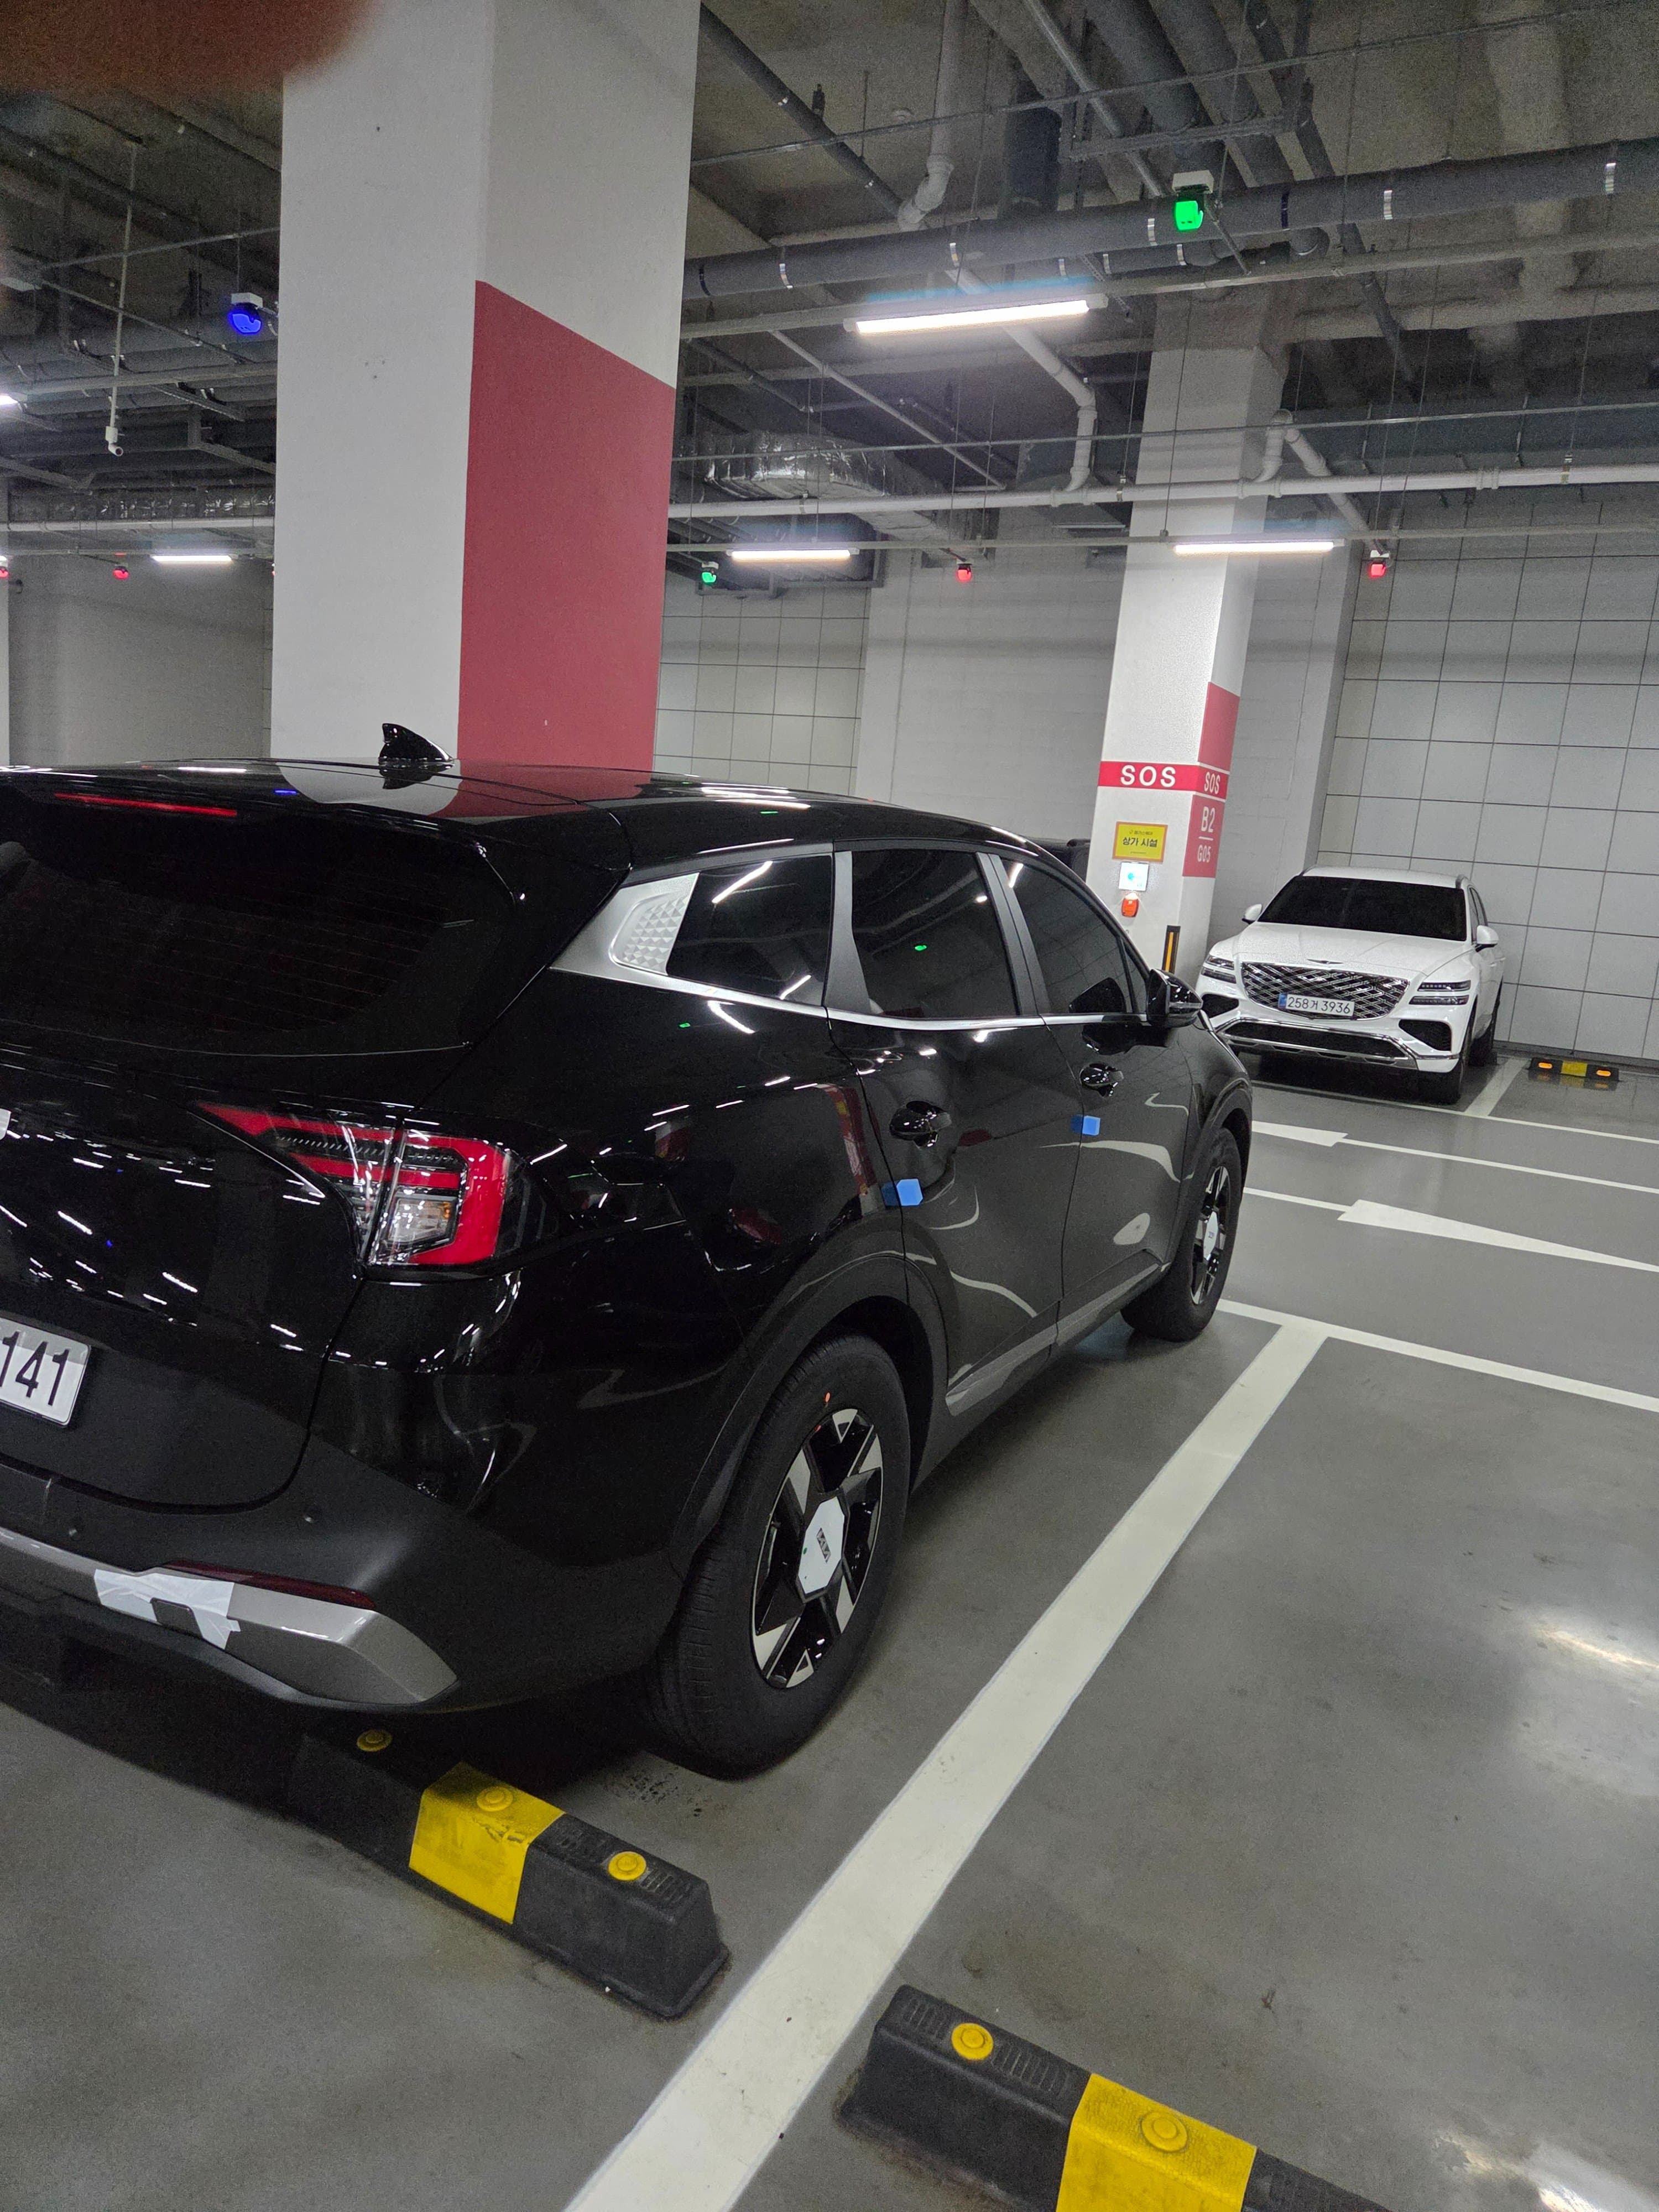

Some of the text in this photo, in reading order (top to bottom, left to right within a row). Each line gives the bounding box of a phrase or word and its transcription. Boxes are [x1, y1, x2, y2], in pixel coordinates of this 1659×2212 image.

[1120, 765, 1176, 787] SOS
[1204, 772, 1220, 794] SOS
[1201, 806, 1215, 832] B2
[1123, 837, 1139, 846] 상가
[1197, 845, 1211, 863] G05
[0, 1329, 70, 1406] 141
